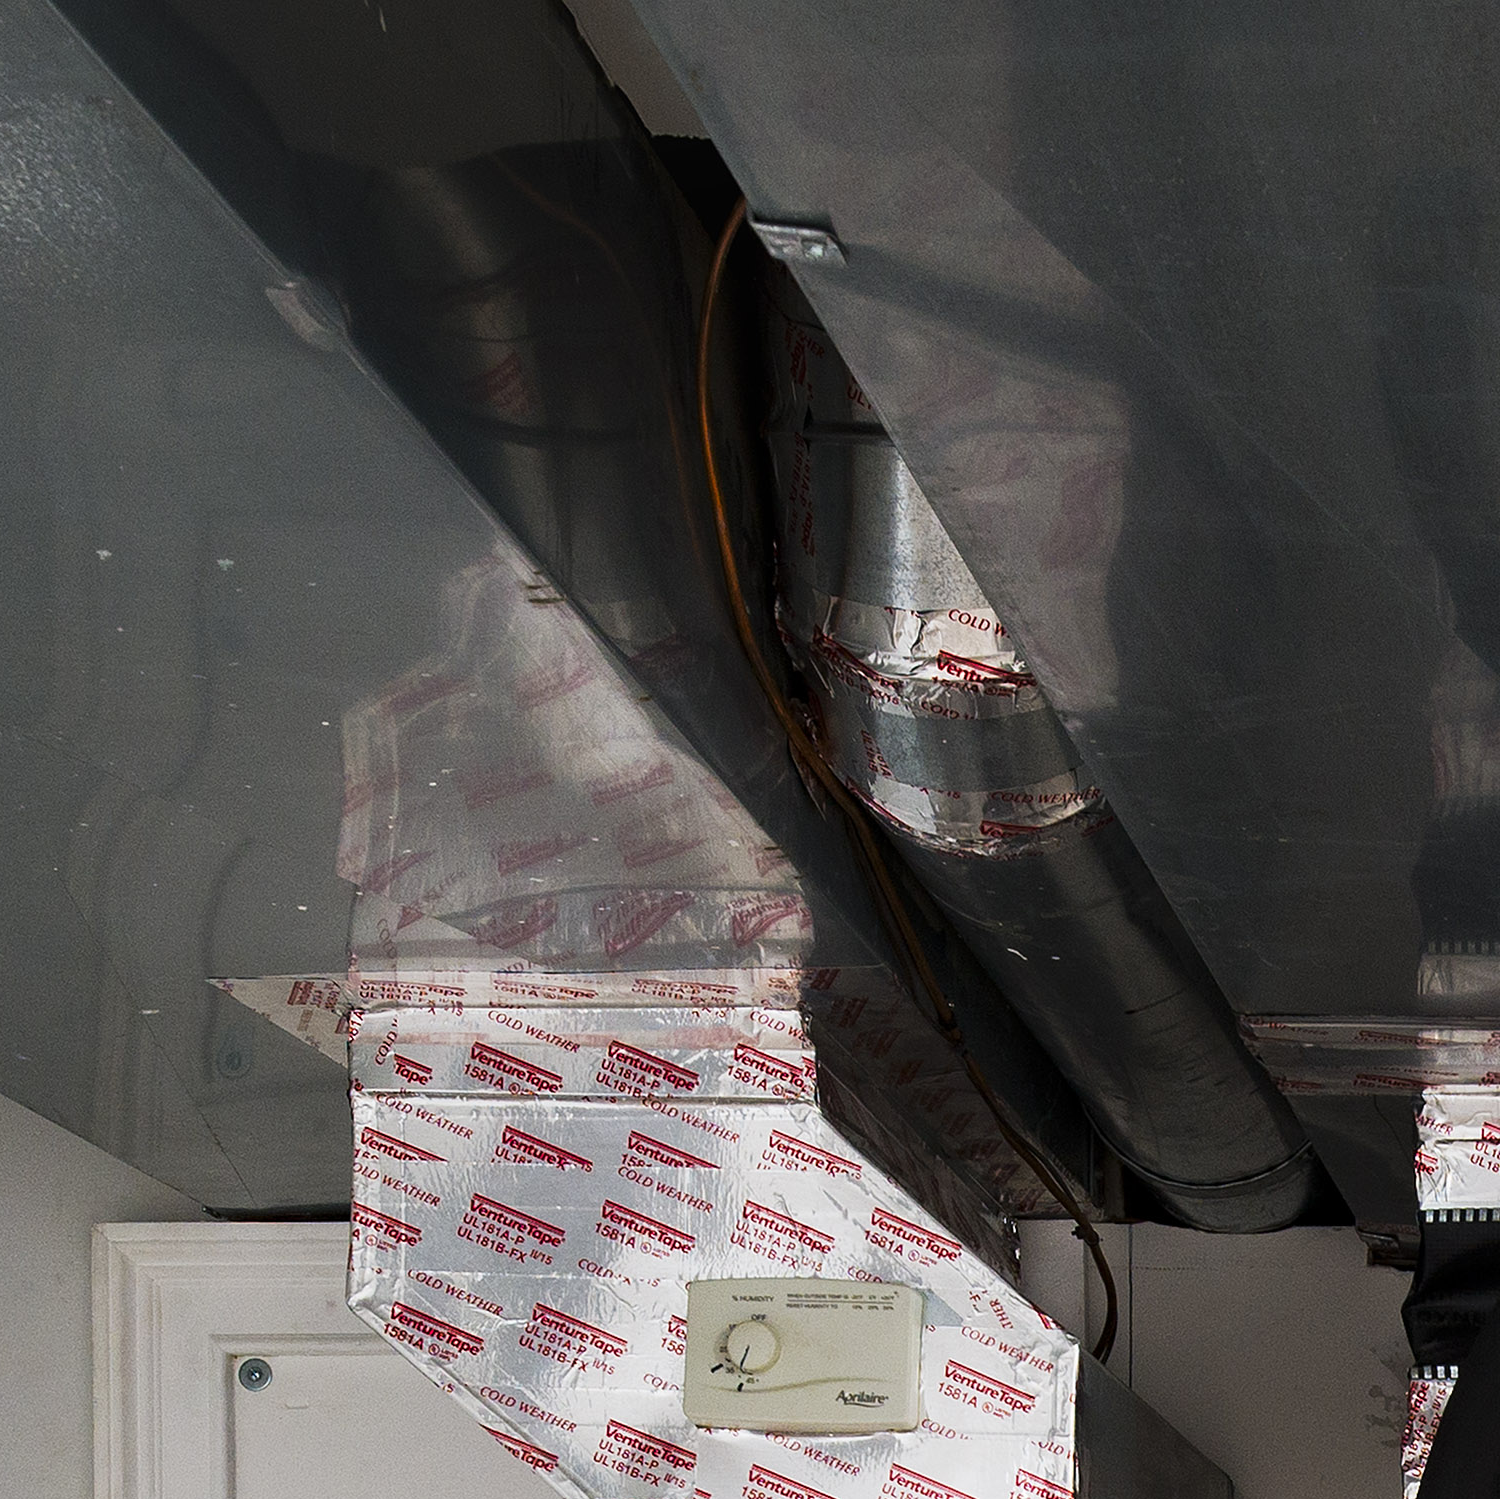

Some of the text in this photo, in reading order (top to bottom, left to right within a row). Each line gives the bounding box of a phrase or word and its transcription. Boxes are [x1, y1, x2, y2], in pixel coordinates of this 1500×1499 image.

[488, 1010, 581, 1053] COLD WEATHER
[607, 1045, 699, 1092] VentureTape
[642, 1099, 740, 1143] COLD WEATHER
[456, 1225, 527, 1264] UL181B-FX
[595, 1221, 636, 1249] 1581A
[735, 1219, 796, 1252] UL181A-P
[863, 1229, 904, 1257] 1581A
[383, 1323, 424, 1351] 1581A
[390, 1307, 484, 1356] VentureTape
[524, 1323, 587, 1355] UL181A-P
[961, 1326, 1054, 1373] COLD WEATHER
[518, 1335, 588, 1372] UL181B-FX
[606, 1424, 697, 1471] VentureTape
[766, 1433, 860, 1477] COLD WEATHER
